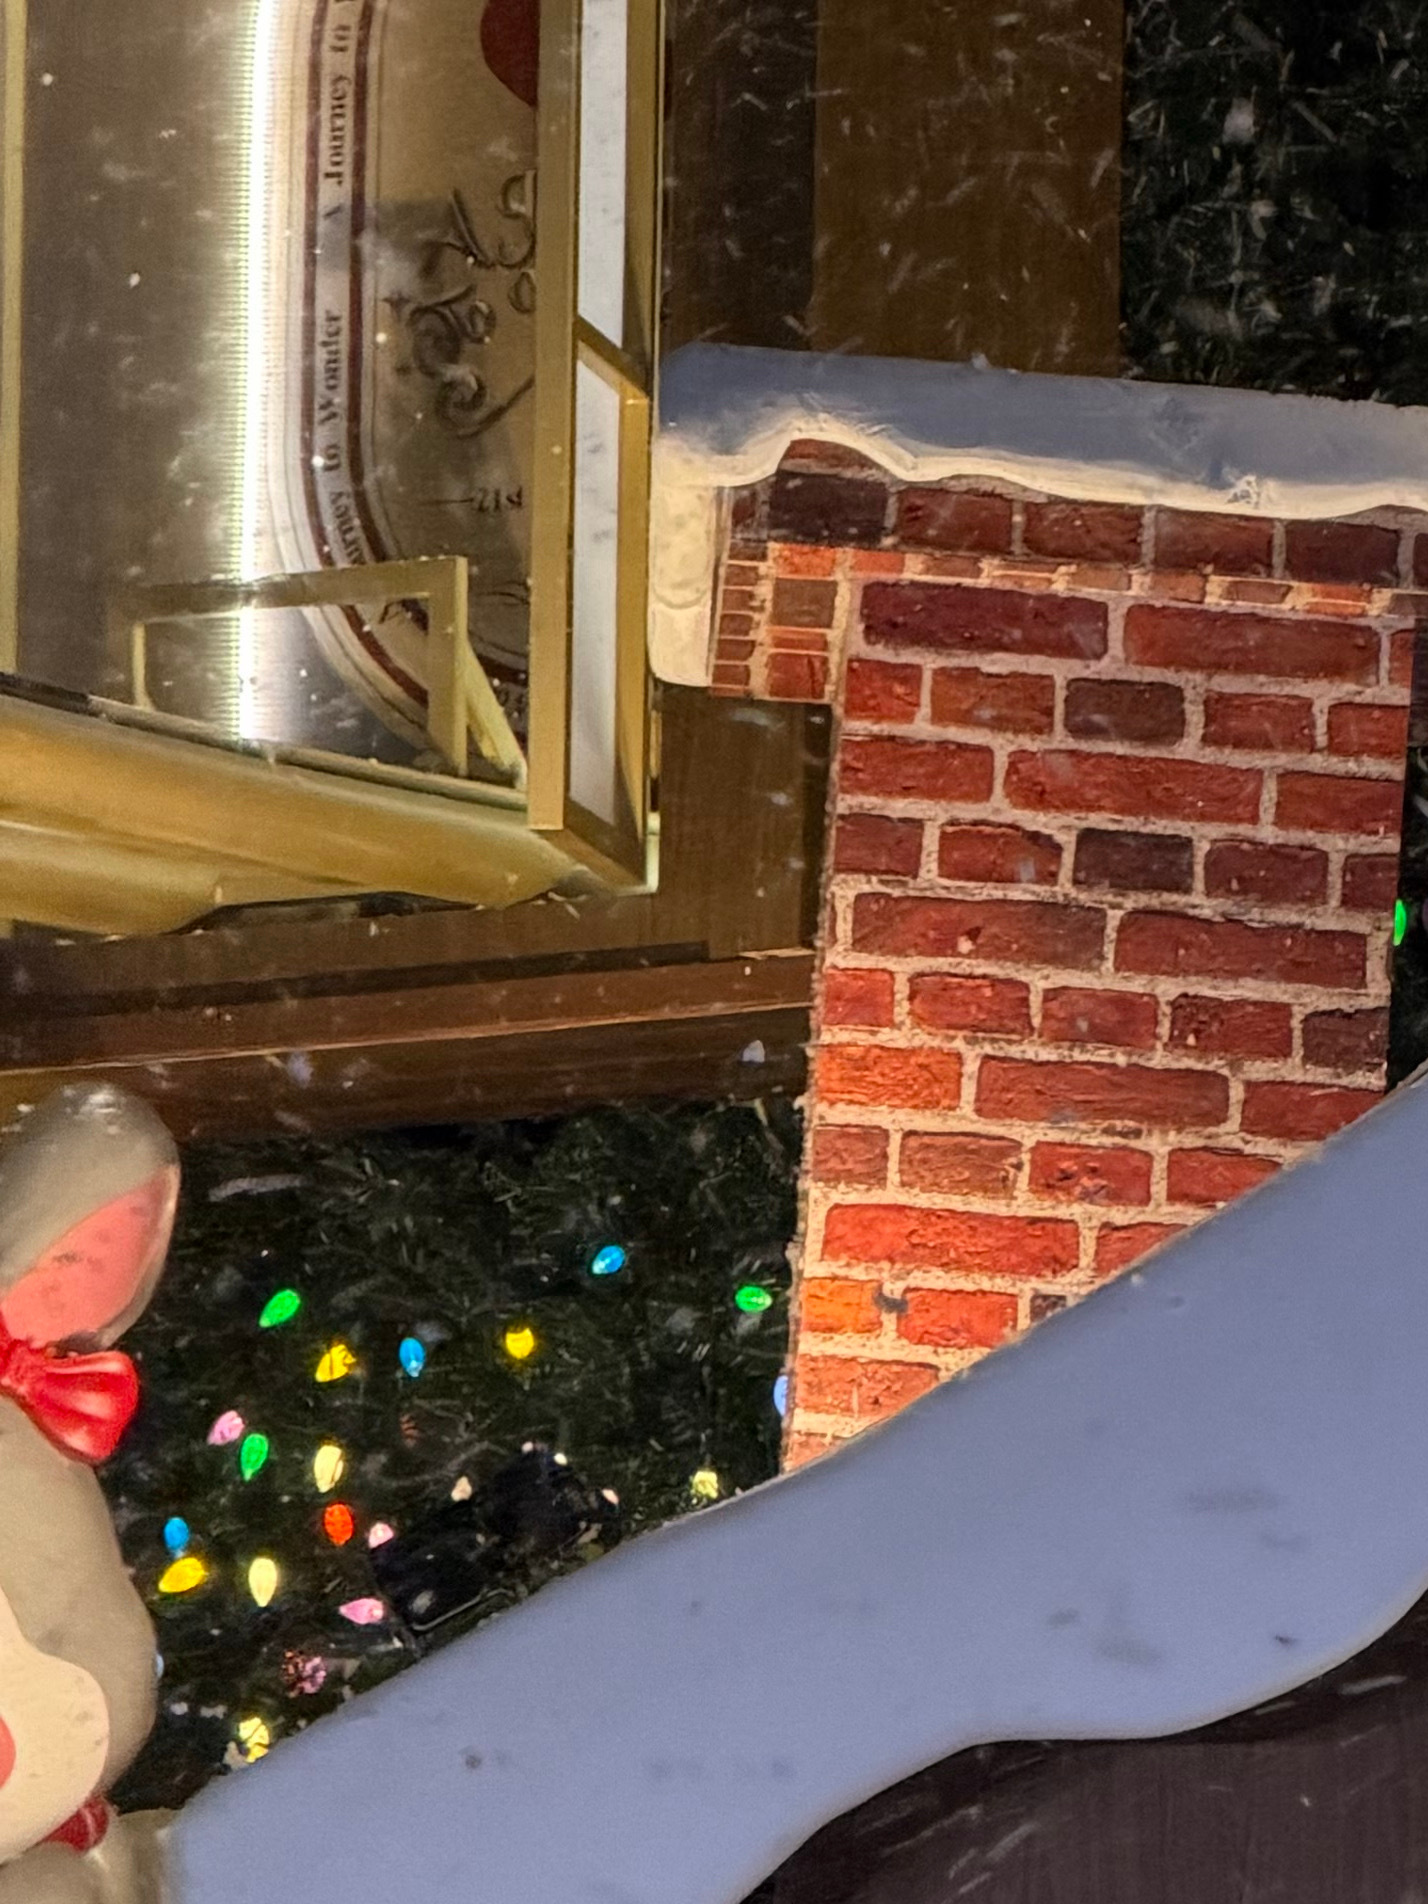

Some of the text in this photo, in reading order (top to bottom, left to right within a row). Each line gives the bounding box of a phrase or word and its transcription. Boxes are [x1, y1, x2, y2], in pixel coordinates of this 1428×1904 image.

[328, 24, 352, 53] to
[323, 74, 352, 187] Journey
[318, 309, 343, 426] Wonder
[322, 444, 342, 473] to
[330, 490, 366, 564] urney
